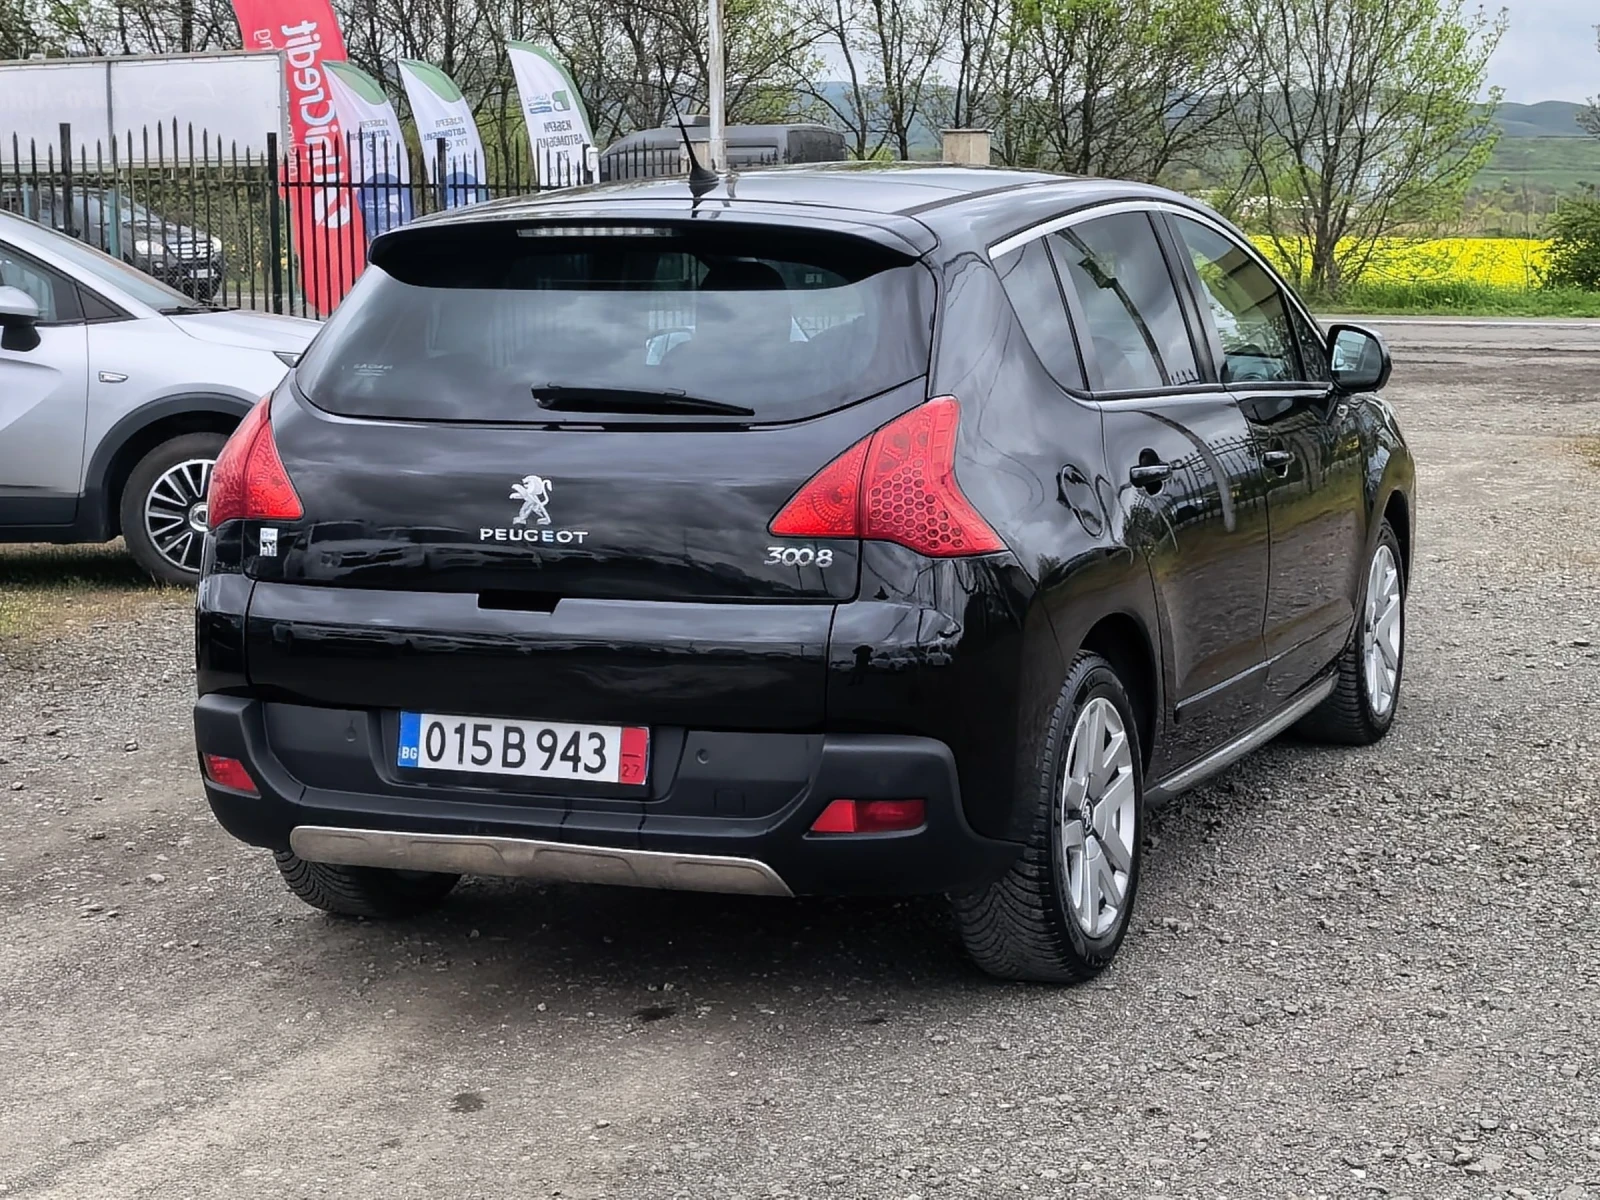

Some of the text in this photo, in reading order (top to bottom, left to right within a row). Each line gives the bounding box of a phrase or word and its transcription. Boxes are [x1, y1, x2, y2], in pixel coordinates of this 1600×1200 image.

[479, 528, 589, 544] PEUGEOT
[764, 546, 834, 568] 3008
[401, 747, 418, 760] BG
